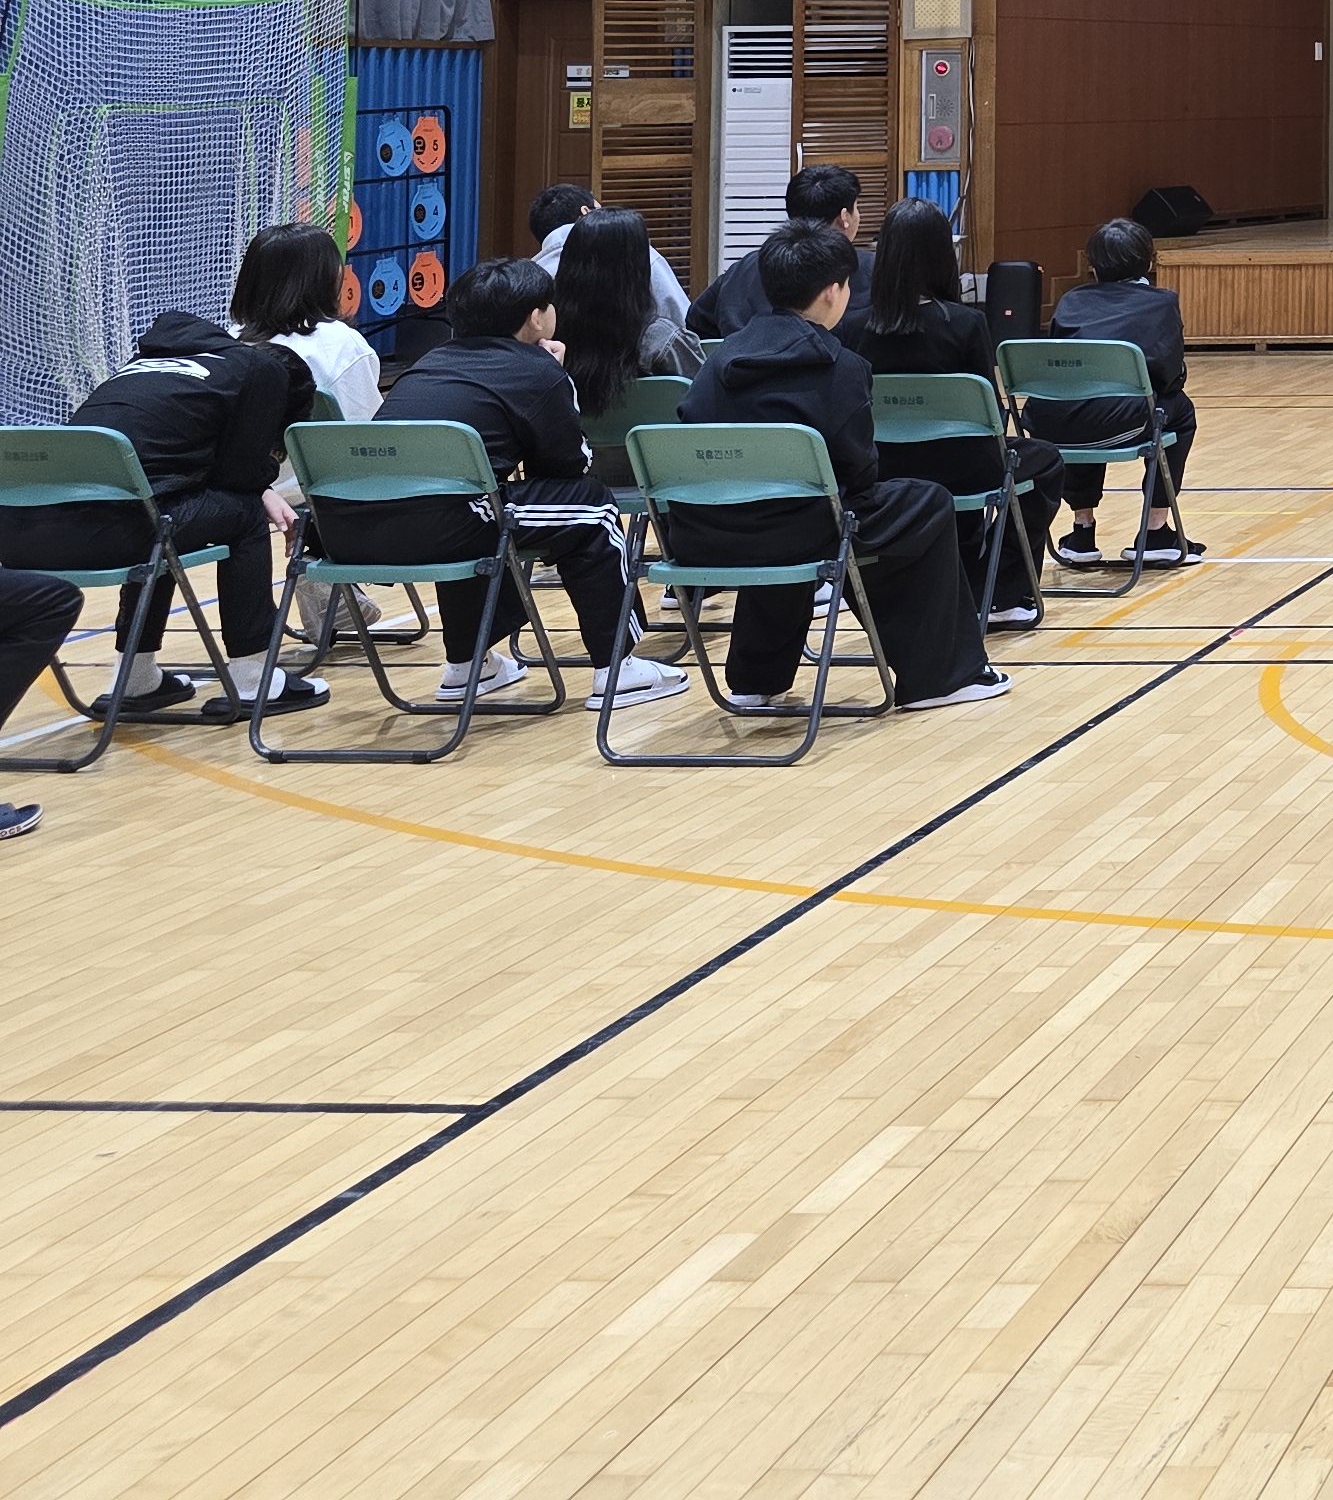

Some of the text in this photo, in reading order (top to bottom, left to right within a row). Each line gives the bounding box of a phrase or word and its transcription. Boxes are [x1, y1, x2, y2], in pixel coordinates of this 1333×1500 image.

[433, 139, 439, 152] 5
[433, 205, 439, 217] 4
[432, 272, 437, 286] 1
[393, 280, 399, 292] 4
[347, 288, 354, 301] 3
